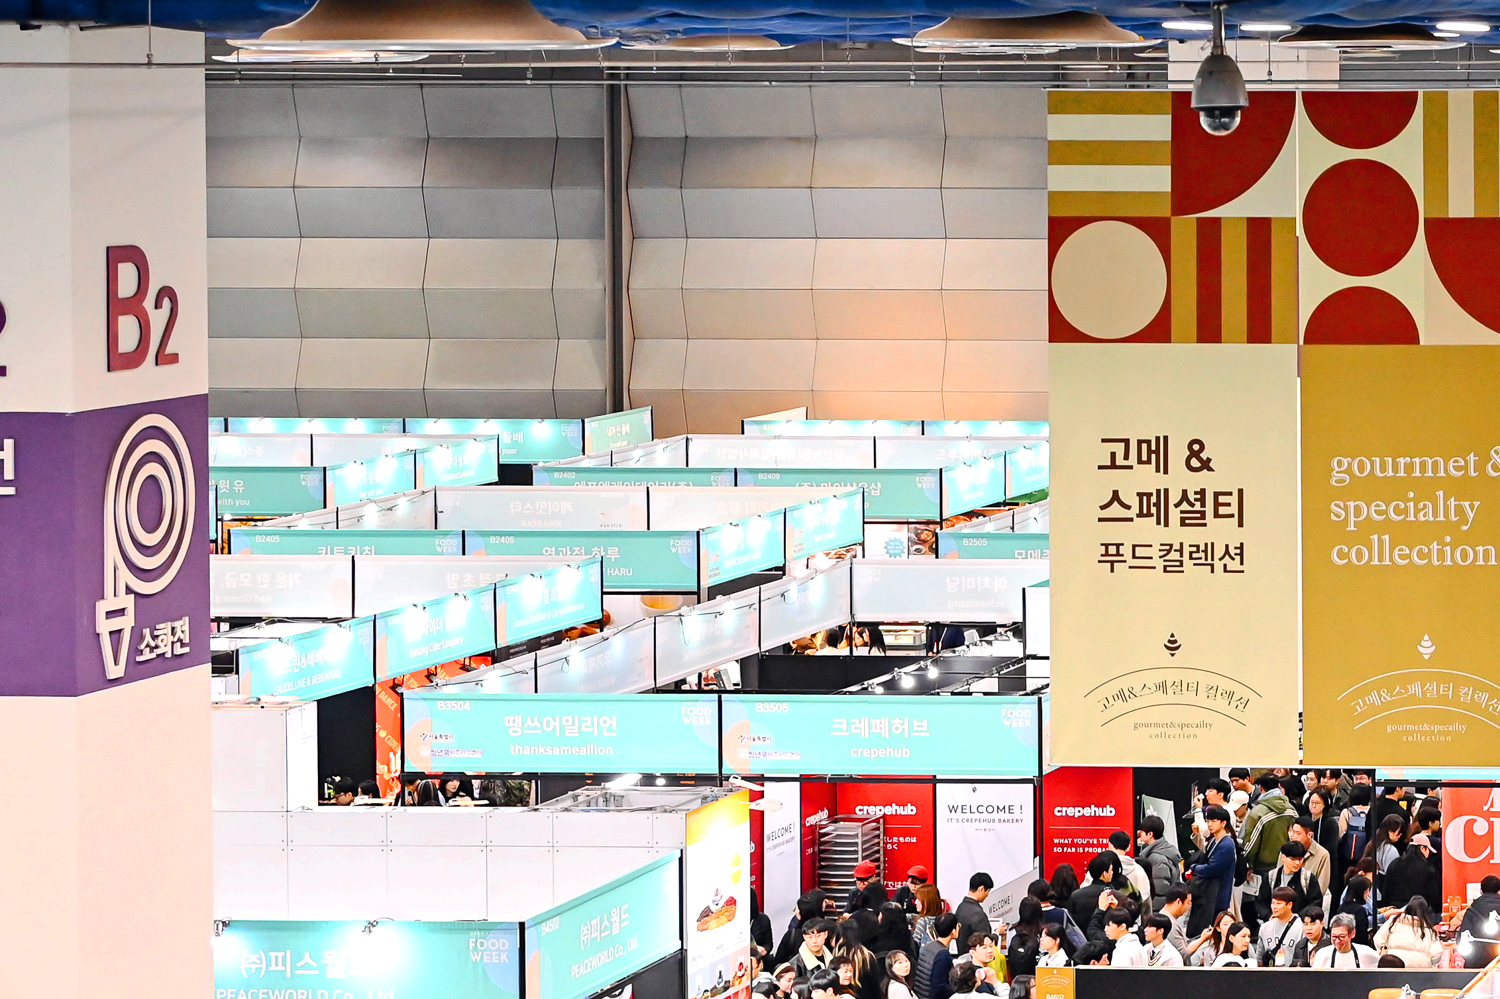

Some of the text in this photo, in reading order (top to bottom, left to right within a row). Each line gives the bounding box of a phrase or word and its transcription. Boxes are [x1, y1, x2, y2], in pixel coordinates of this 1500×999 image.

[106, 244, 180, 372] B2
[1097, 435, 1216, 475] 고메 &
[1330, 452, 1480, 486] gourmet
[1097, 487, 1245, 529] 스페셜티
[1330, 490, 1481, 531] specialty
[255, 534, 280, 543] B2405
[489, 535, 515, 544] B2406
[962, 538, 988, 546] B2505
[1331, 534, 1499, 567] collection
[1097, 541, 1246, 574] 푸드컬렉션
[607, 568, 633, 576] HARU
[135, 615, 191, 662] 소화전
[1098, 678, 1252, 714] 고메&스페셜티 컬렉션
[1349, 680, 1455, 717] 고메&스페셜티
[437, 701, 471, 711] B3504
[681, 707, 712, 716] FOOD
[755, 702, 789, 713] B3505
[1001, 709, 1032, 718] FOOD
[504, 715, 618, 736] 땡쓰어밀리언
[682, 716, 712, 726] WEEK
[830, 717, 930, 738] 크레페허브
[1002, 718, 1032, 728] WEEK
[1149, 731, 1198, 740] collection
[1402, 733, 1452, 742] collection
[510, 743, 614, 756] thanksameallion
[850, 746, 910, 760] crepehub
[855, 802, 917, 816] crepehub
[947, 804, 1015, 814] WELCOME
[1053, 804, 1116, 818] crepehub
[468, 938, 510, 950] FOOD
[469, 951, 510, 964] WEEK
